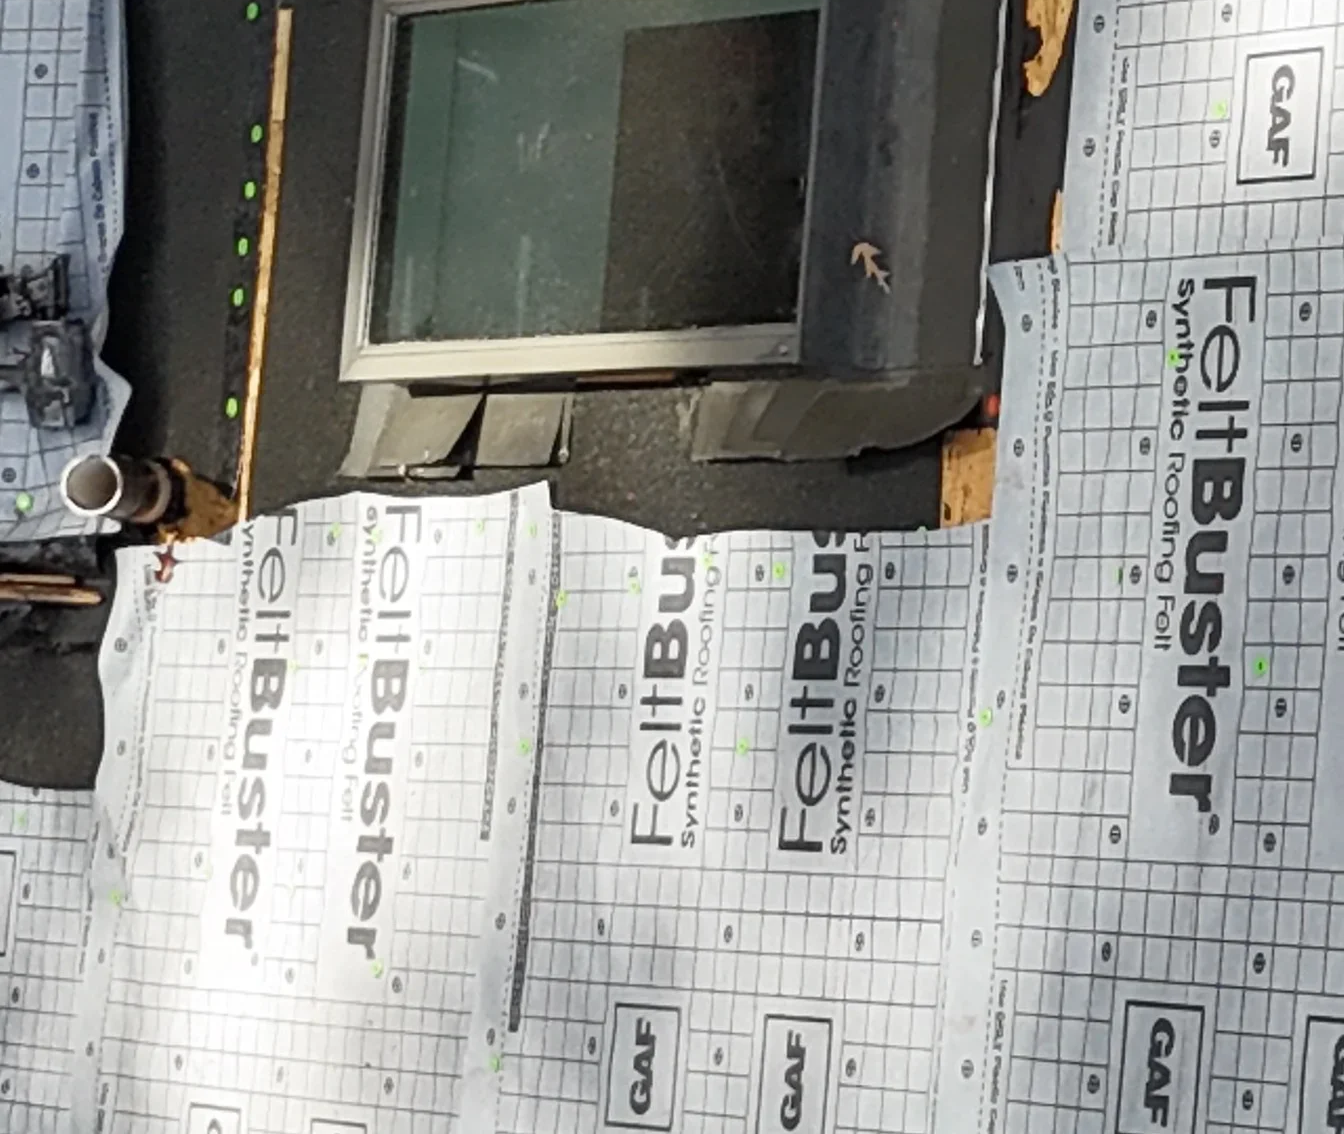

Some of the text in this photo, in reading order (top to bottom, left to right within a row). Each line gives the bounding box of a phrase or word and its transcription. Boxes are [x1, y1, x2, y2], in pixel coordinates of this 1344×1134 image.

[1155, 278, 1197, 652] Synthetic Roofing Felt
[692, 563, 723, 687] Roofing
[843, 562, 874, 687] Roofing
[681, 696, 706, 848] Synthetic
[831, 698, 857, 855] Synthetic
[628, 1017, 656, 1115] GAF
[780, 1028, 807, 1131] GAF
[1143, 1017, 1177, 1128] GAF
